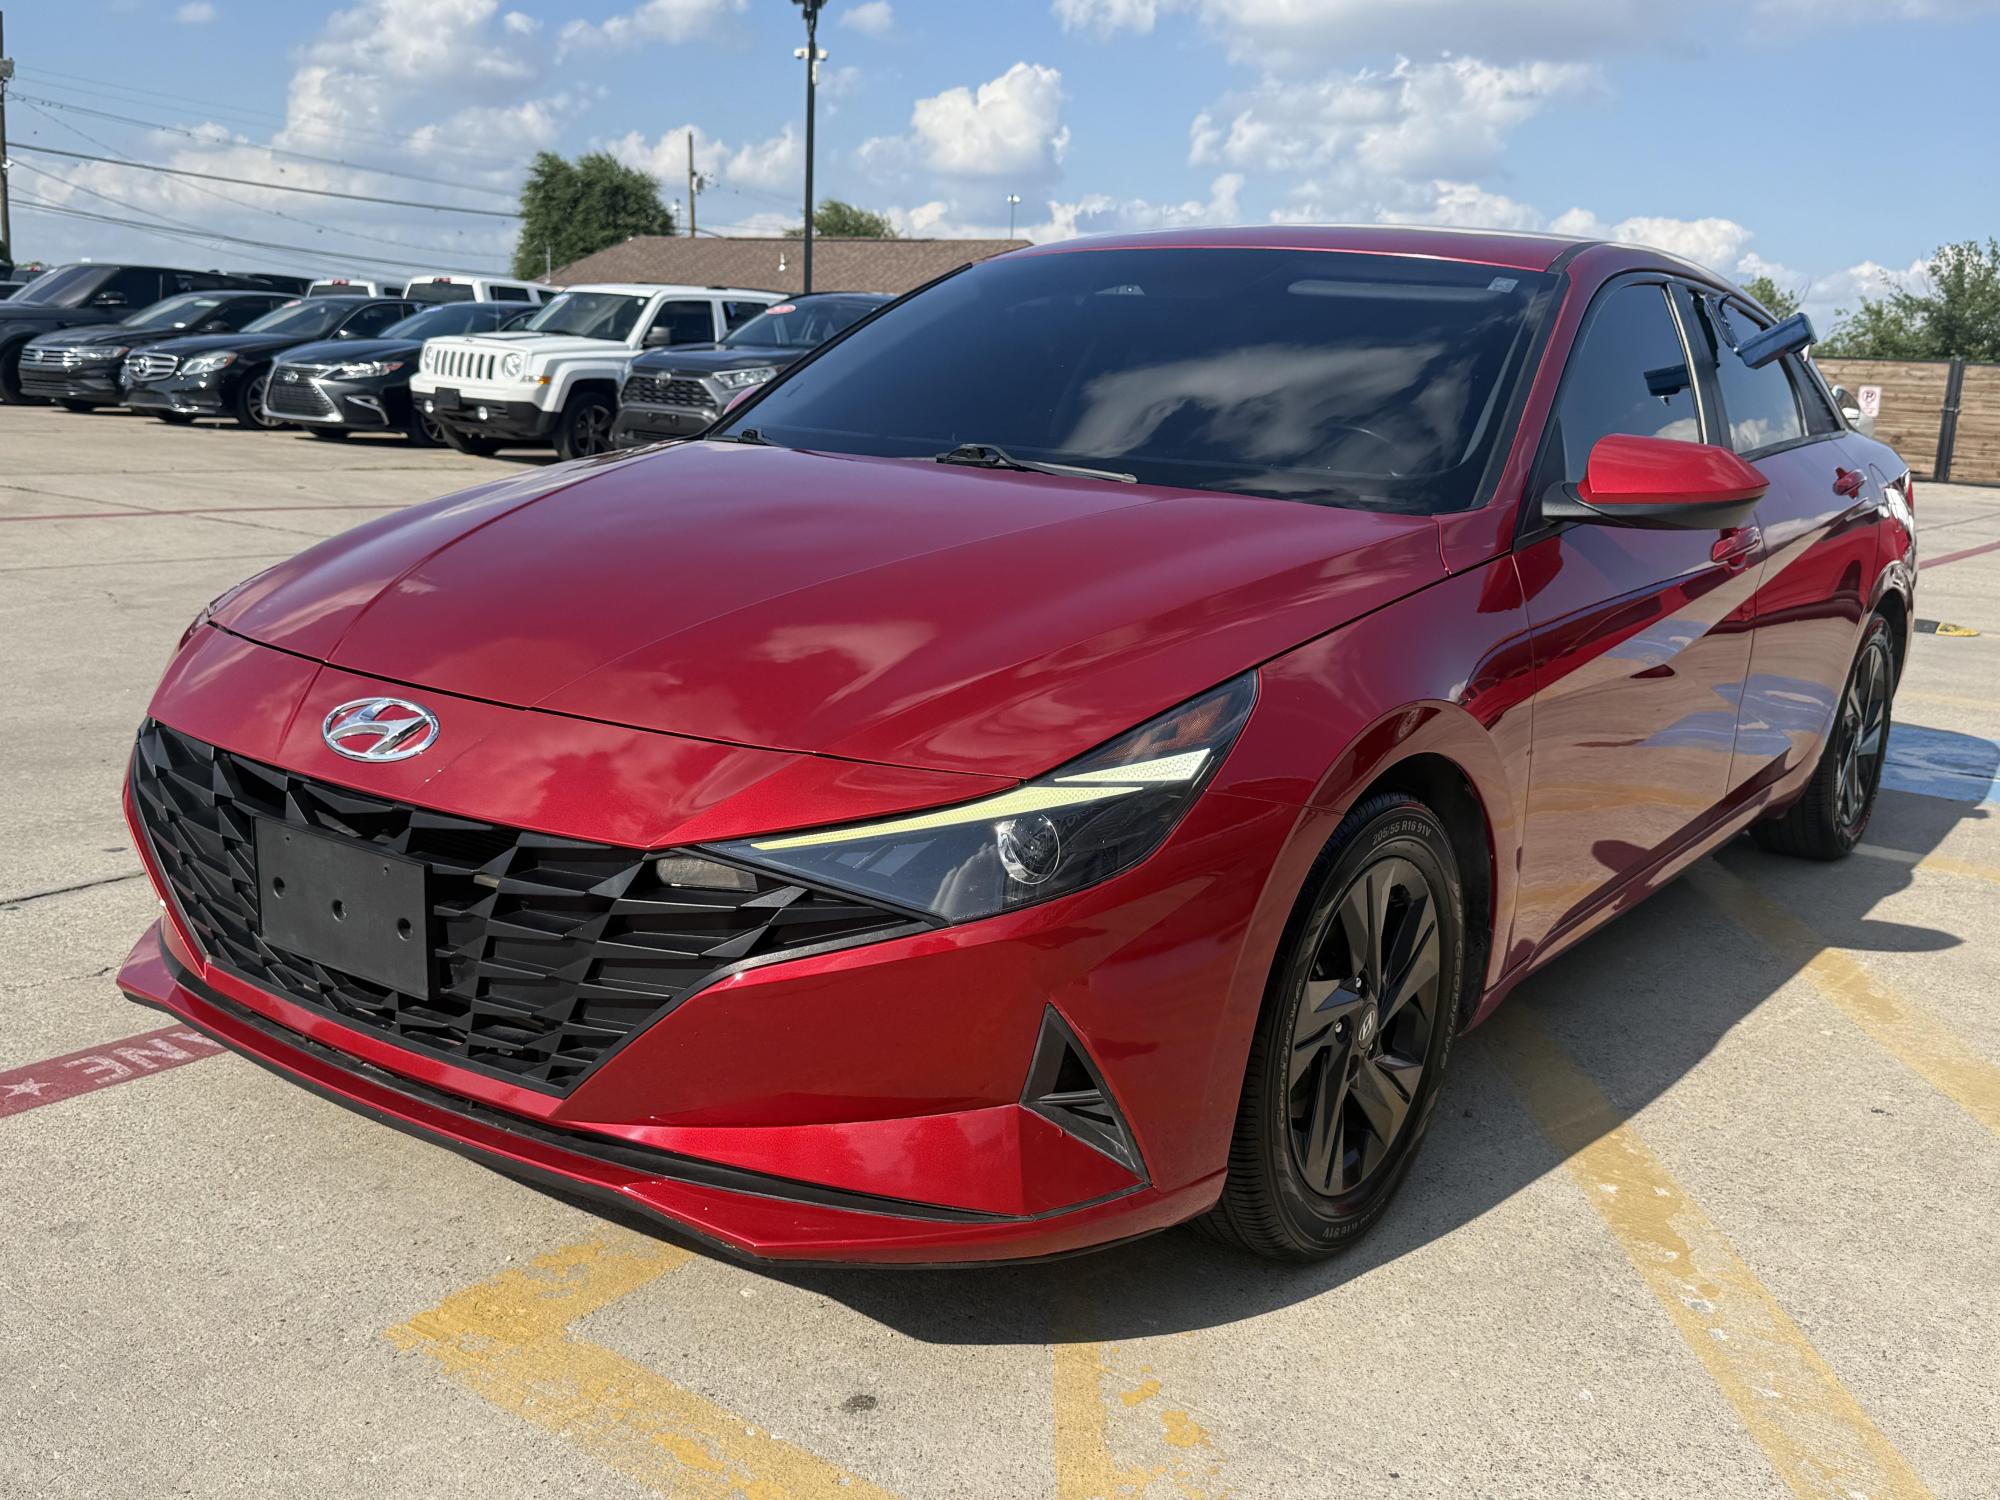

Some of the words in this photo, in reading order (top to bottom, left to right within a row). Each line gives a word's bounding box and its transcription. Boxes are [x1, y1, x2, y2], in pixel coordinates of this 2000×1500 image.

[1372, 822, 1400, 845] 205/55
[1401, 820, 1417, 832] R16
[1417, 822, 1431, 837] 91V
